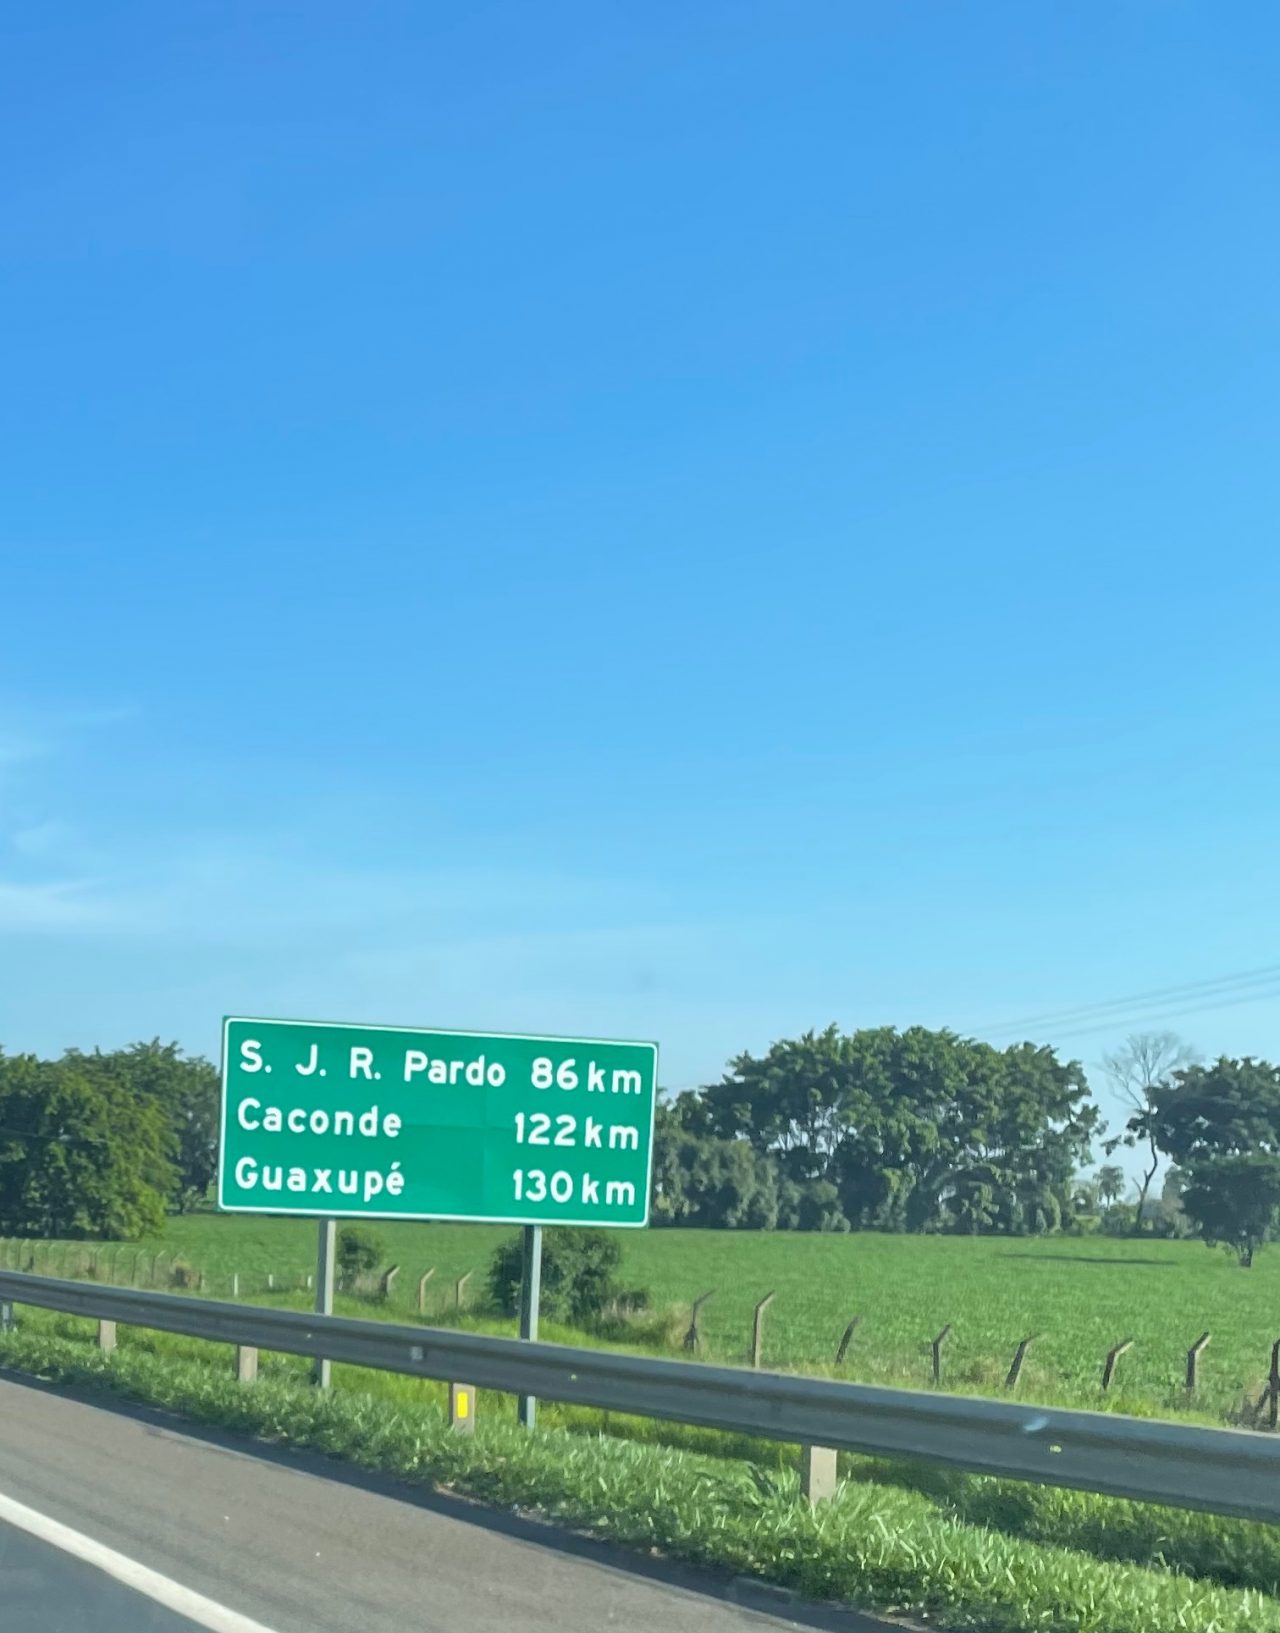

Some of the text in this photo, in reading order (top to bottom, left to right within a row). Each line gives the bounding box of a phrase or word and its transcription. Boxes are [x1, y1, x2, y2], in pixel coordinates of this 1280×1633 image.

[239, 1039, 272, 1073] S.
[295, 1044, 326, 1077] J.
[349, 1046, 381, 1080] R.
[404, 1050, 506, 1087] Pardo
[237, 1098, 402, 1138] Caconde
[235, 1157, 405, 1202] Guaxupé
